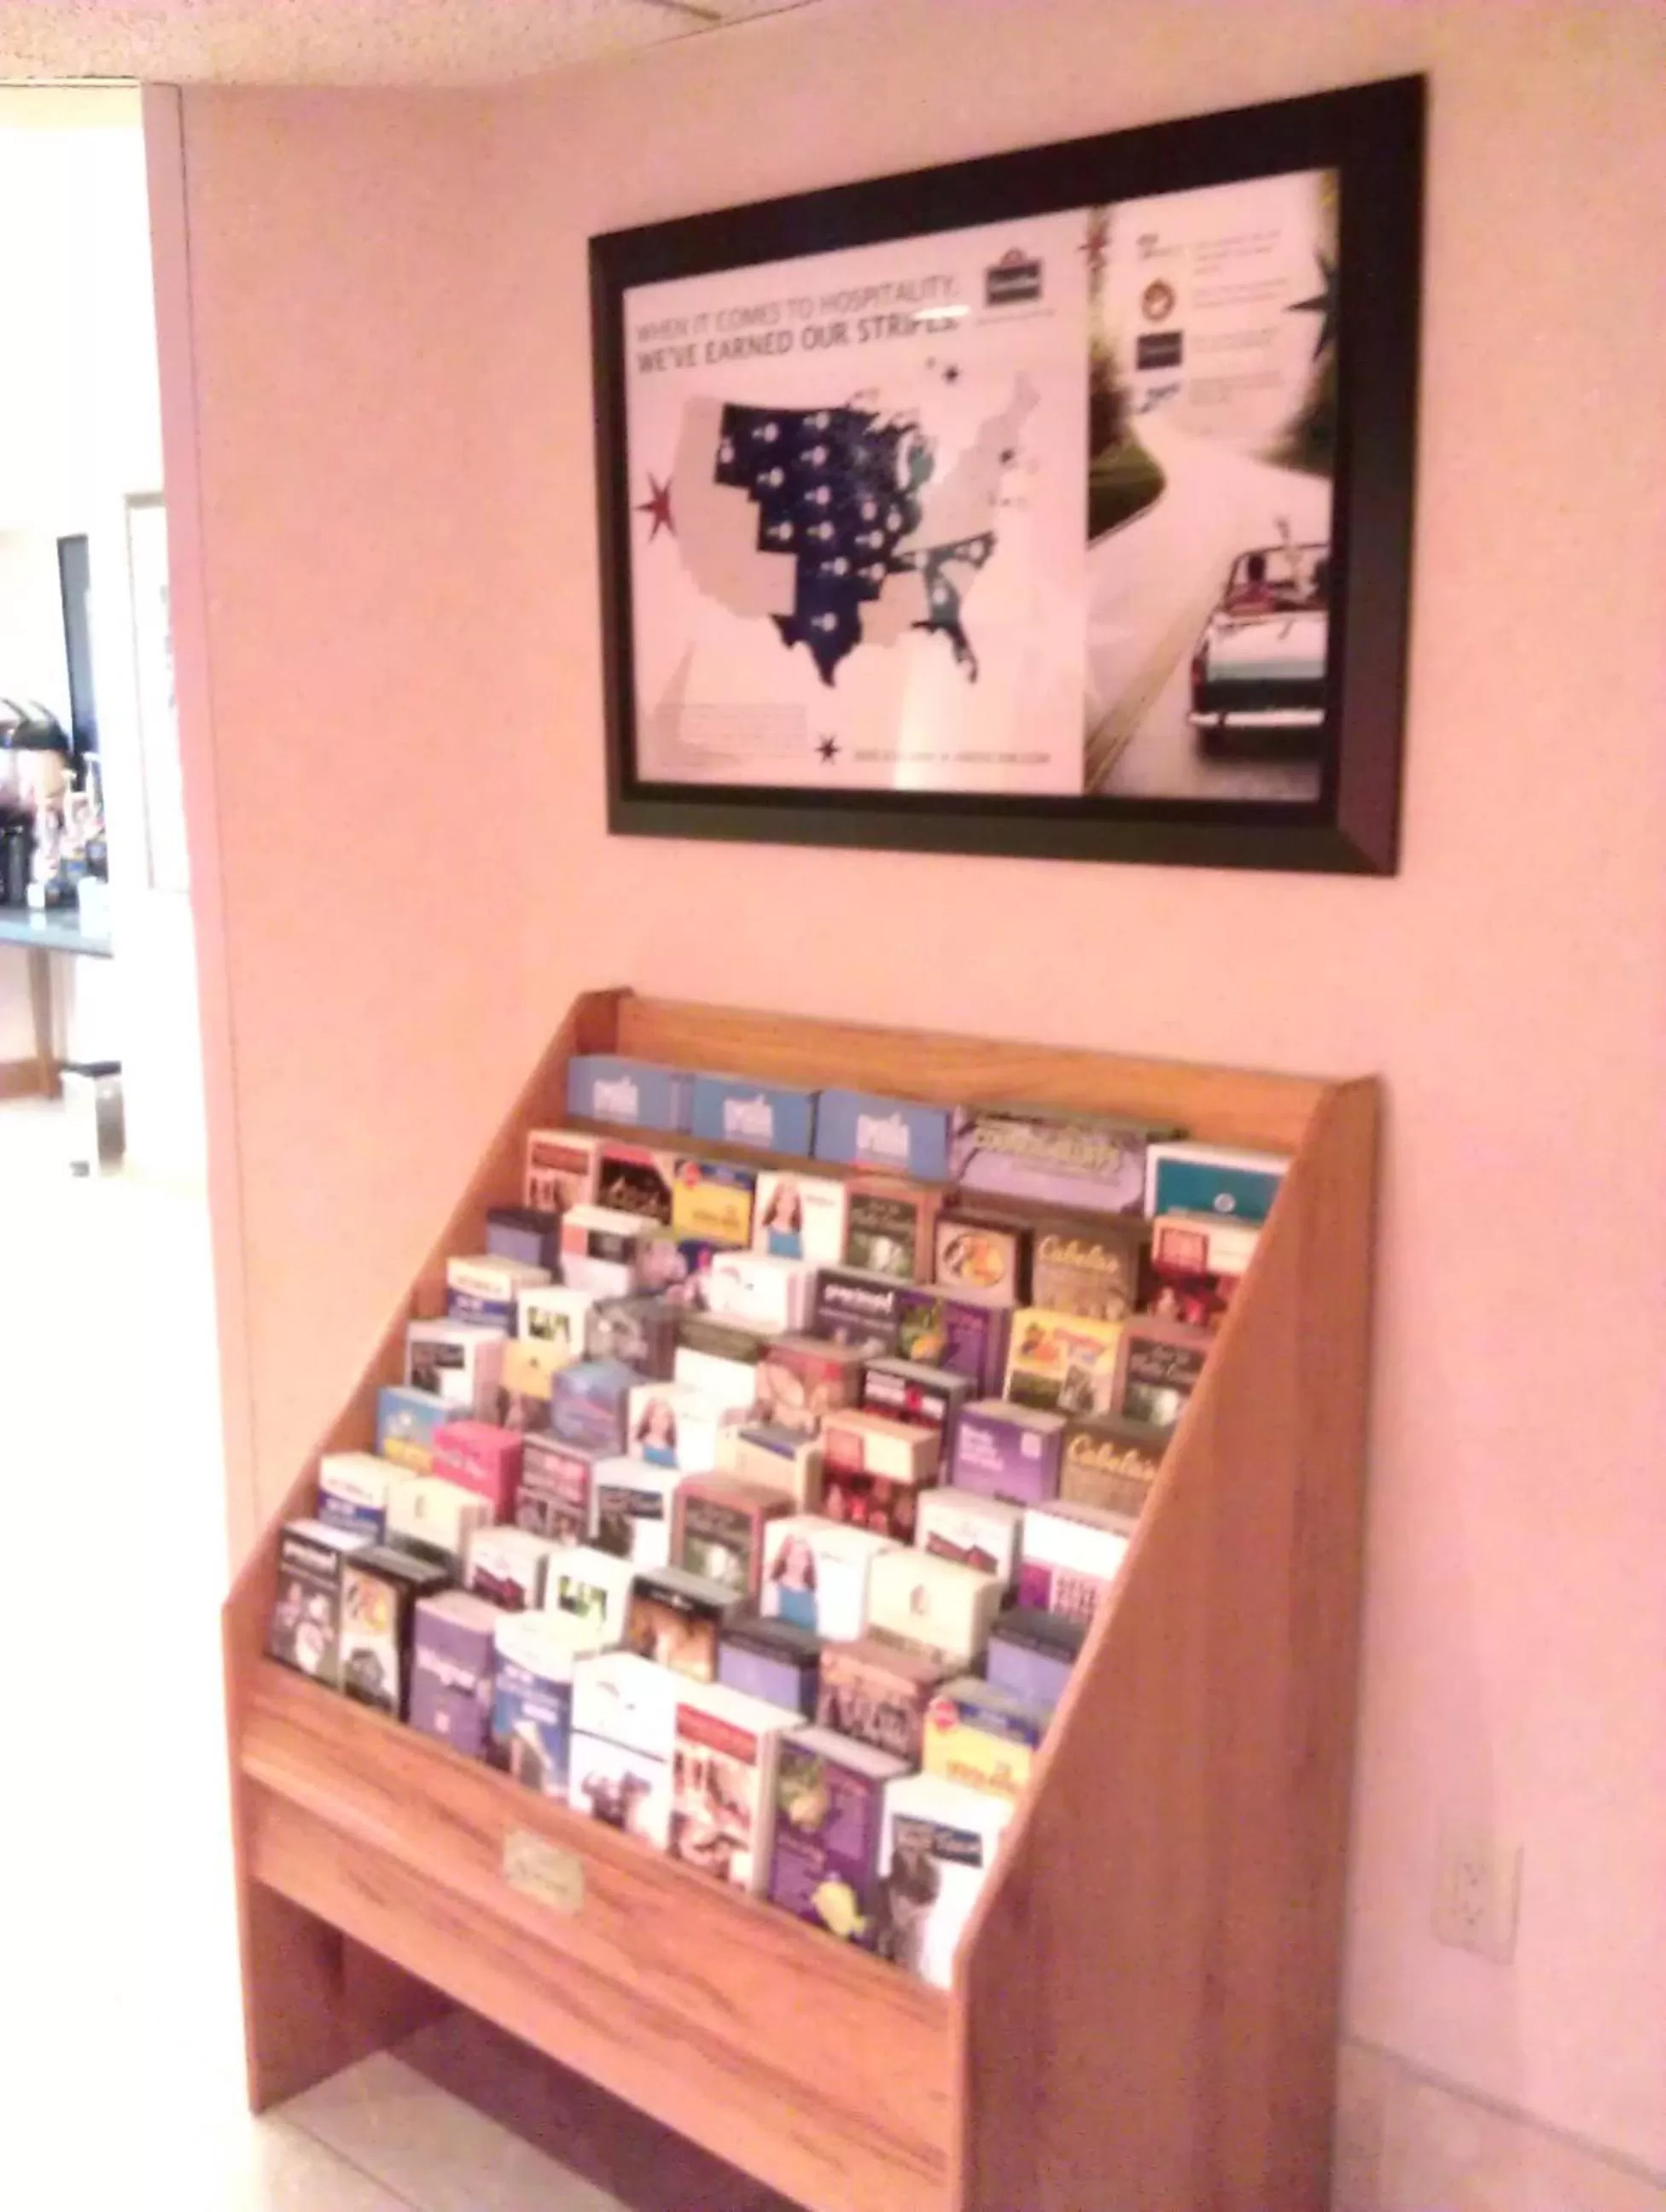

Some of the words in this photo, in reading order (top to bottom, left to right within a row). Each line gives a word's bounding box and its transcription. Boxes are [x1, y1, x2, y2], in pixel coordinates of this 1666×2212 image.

[638, 317, 689, 341] WHEN
[694, 312, 709, 334] IT
[715, 302, 781, 332] COMES
[787, 296, 814, 321] TO
[638, 344, 697, 374] WE'VE
[705, 330, 794, 365] EARNED
[800, 322, 848, 351] OUR
